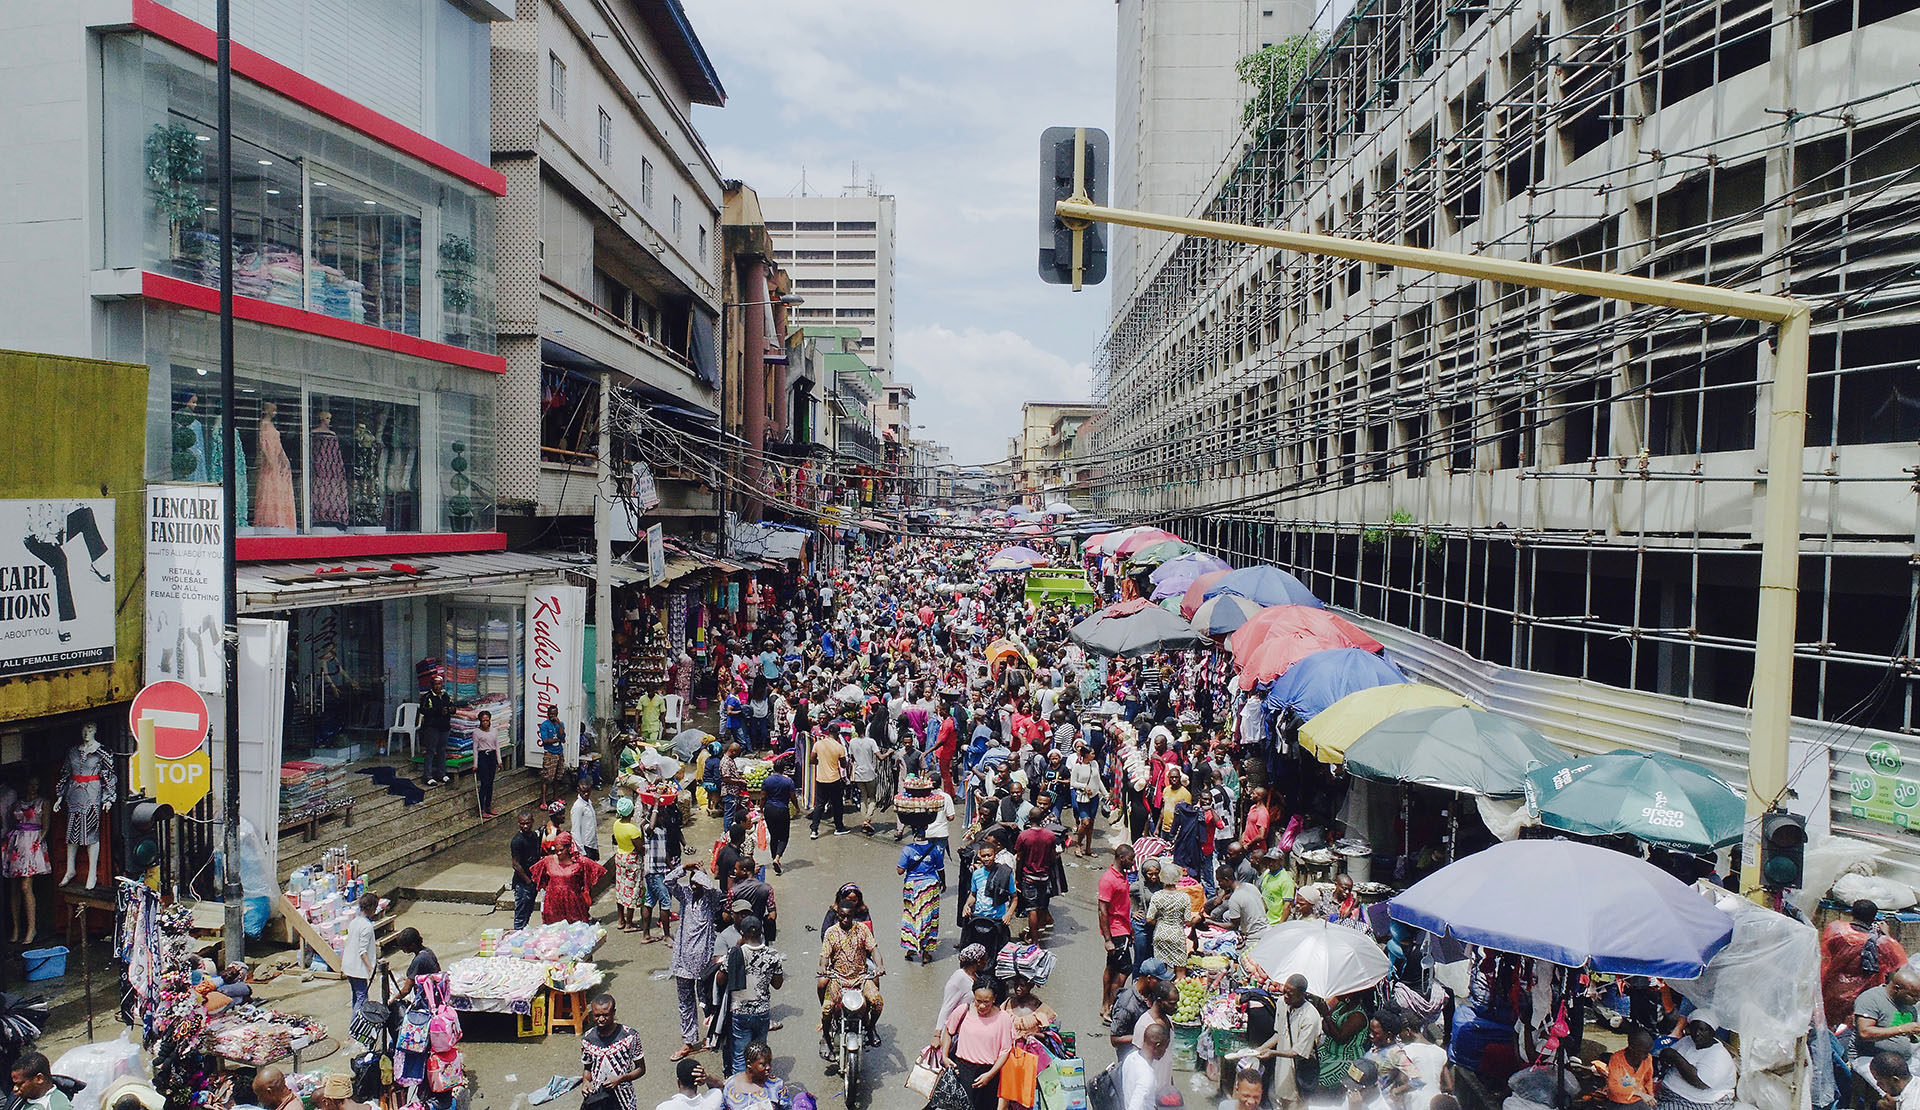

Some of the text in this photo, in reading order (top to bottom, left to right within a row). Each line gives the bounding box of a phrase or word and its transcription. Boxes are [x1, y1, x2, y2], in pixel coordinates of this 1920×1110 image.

[152, 496, 219, 520] LENCARL
[151, 521, 221, 546] FASHIONS
[170, 549, 184, 557] ALL
[184, 550, 206, 558] ABOUT
[168, 567, 194, 575] RETAIL
[161, 576, 208, 584] WHOLESALE
[150, 590, 220, 601] FEMALE CLOTHING
[4, 629, 32, 639] ABOUT
[3, 659, 21, 668] ALL
[22, 654, 59, 665] FEMALE
[60, 648, 103, 661] CLOTHING
[1869, 749, 1897, 768] glo
[155, 762, 203, 785] TOP
[1850, 777, 1871, 796] glo
[1894, 783, 1916, 803] glo
[1641, 806, 1684, 819] green
[1648, 815, 1684, 828] lotto
